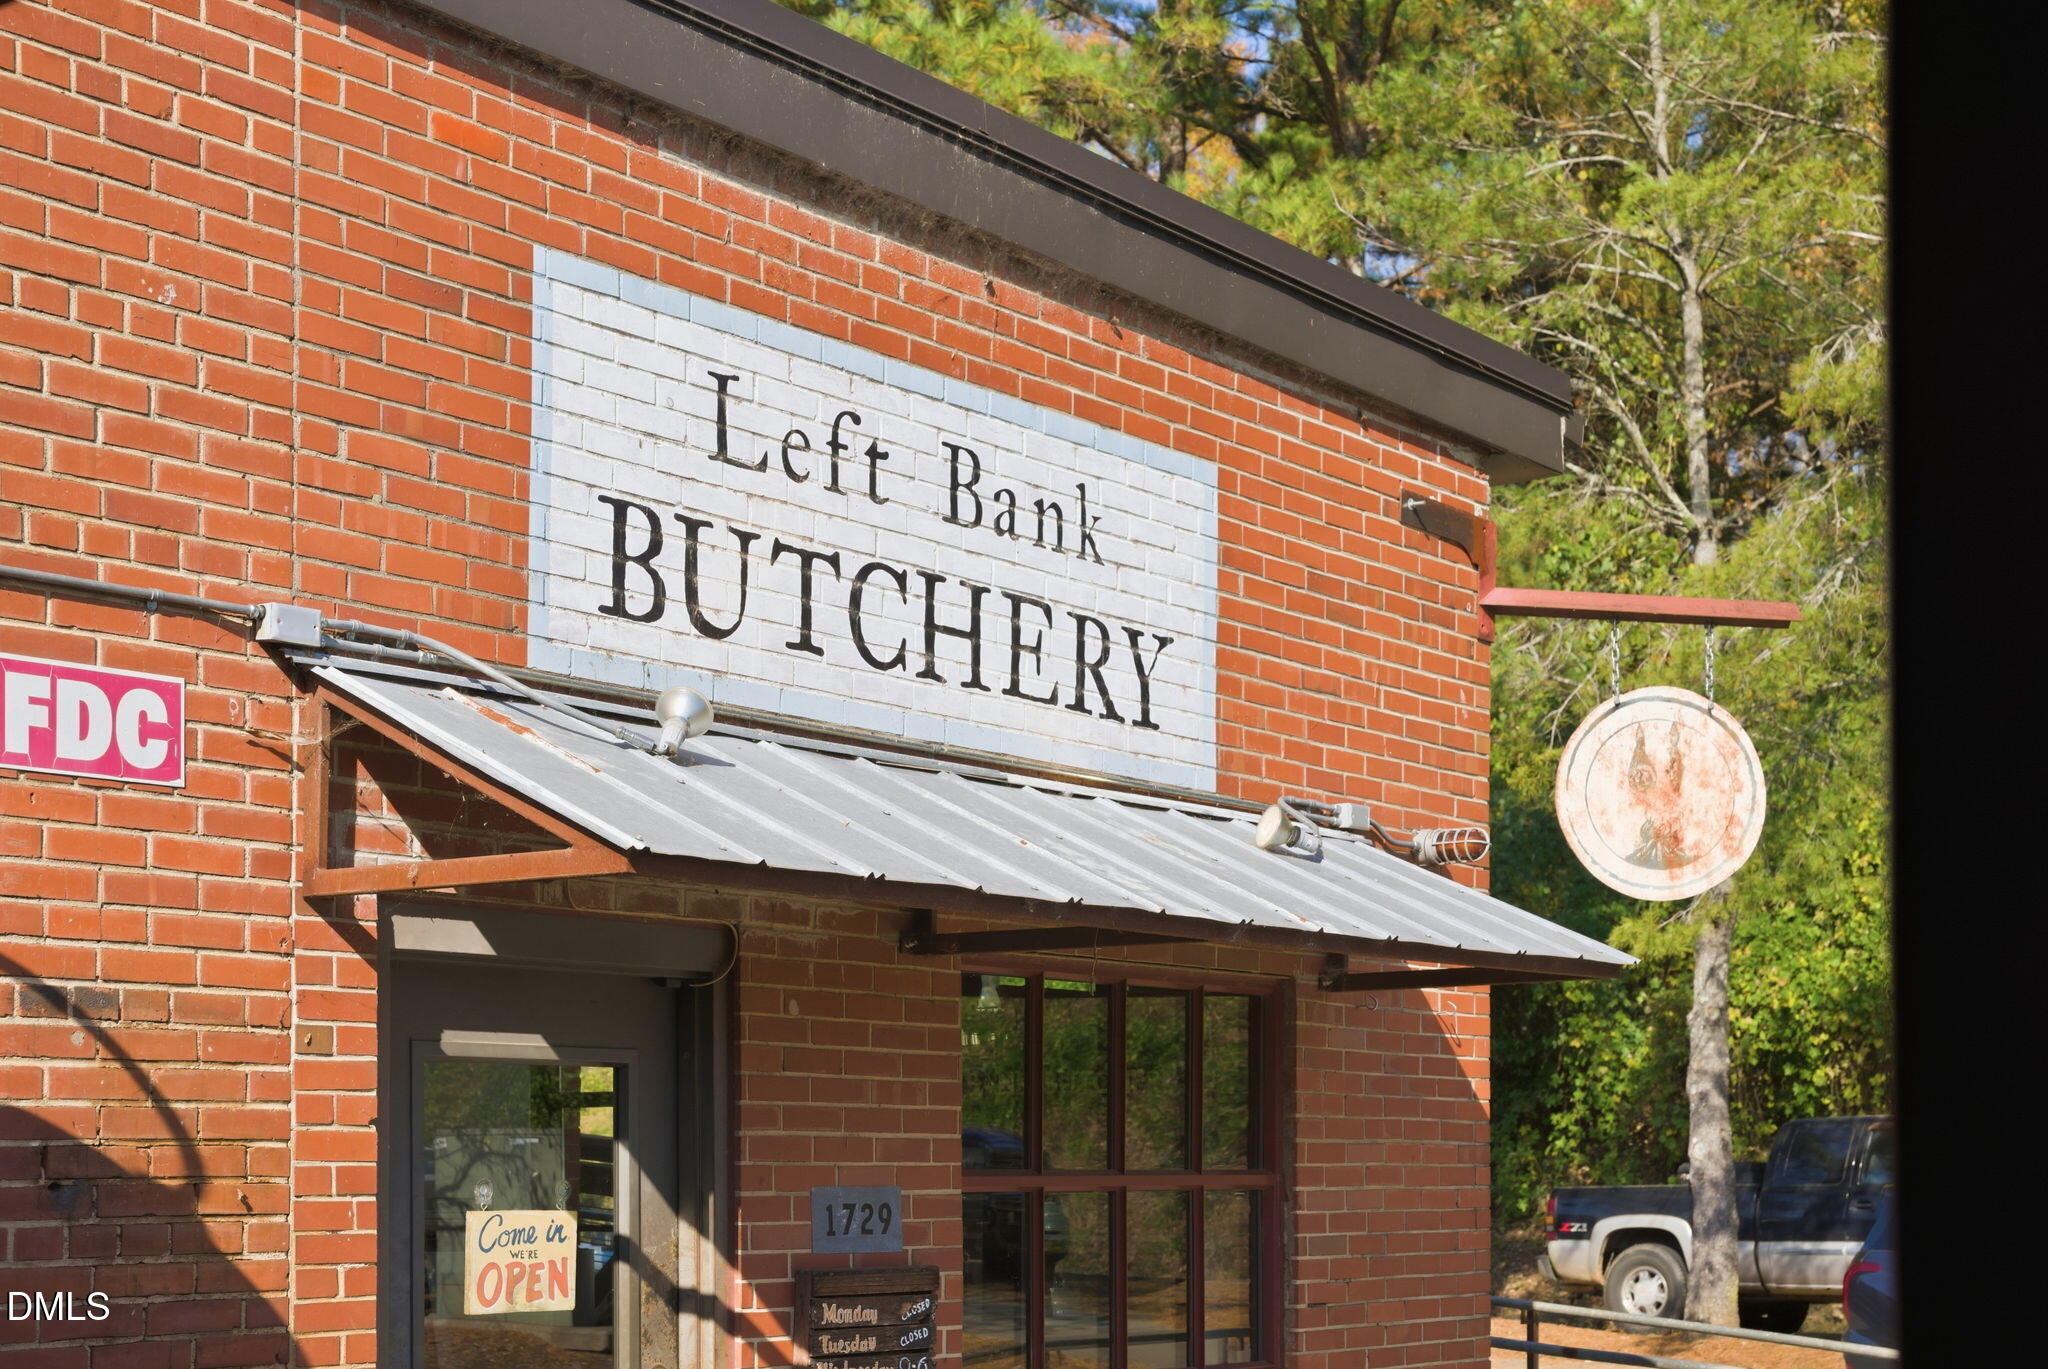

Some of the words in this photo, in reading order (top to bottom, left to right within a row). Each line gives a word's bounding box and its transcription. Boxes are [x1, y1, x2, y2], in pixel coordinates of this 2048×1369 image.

[706, 369, 890, 505] Left
[940, 441, 1104, 566] Bank
[597, 494, 1175, 731] BUTCHERY
[4, 671, 169, 770] FDC
[478, 1213, 538, 1254] Come
[545, 1219, 568, 1244] in
[825, 1202, 893, 1237] 1729
[1559, 1222, 1588, 1233] Z71
[509, 1249, 538, 1260] WE'RE
[476, 1256, 570, 1308] OPEN
[821, 1302, 878, 1325] Monday
[818, 1334, 877, 1354] Tuesday
[900, 1327, 929, 1347] CLOSED
